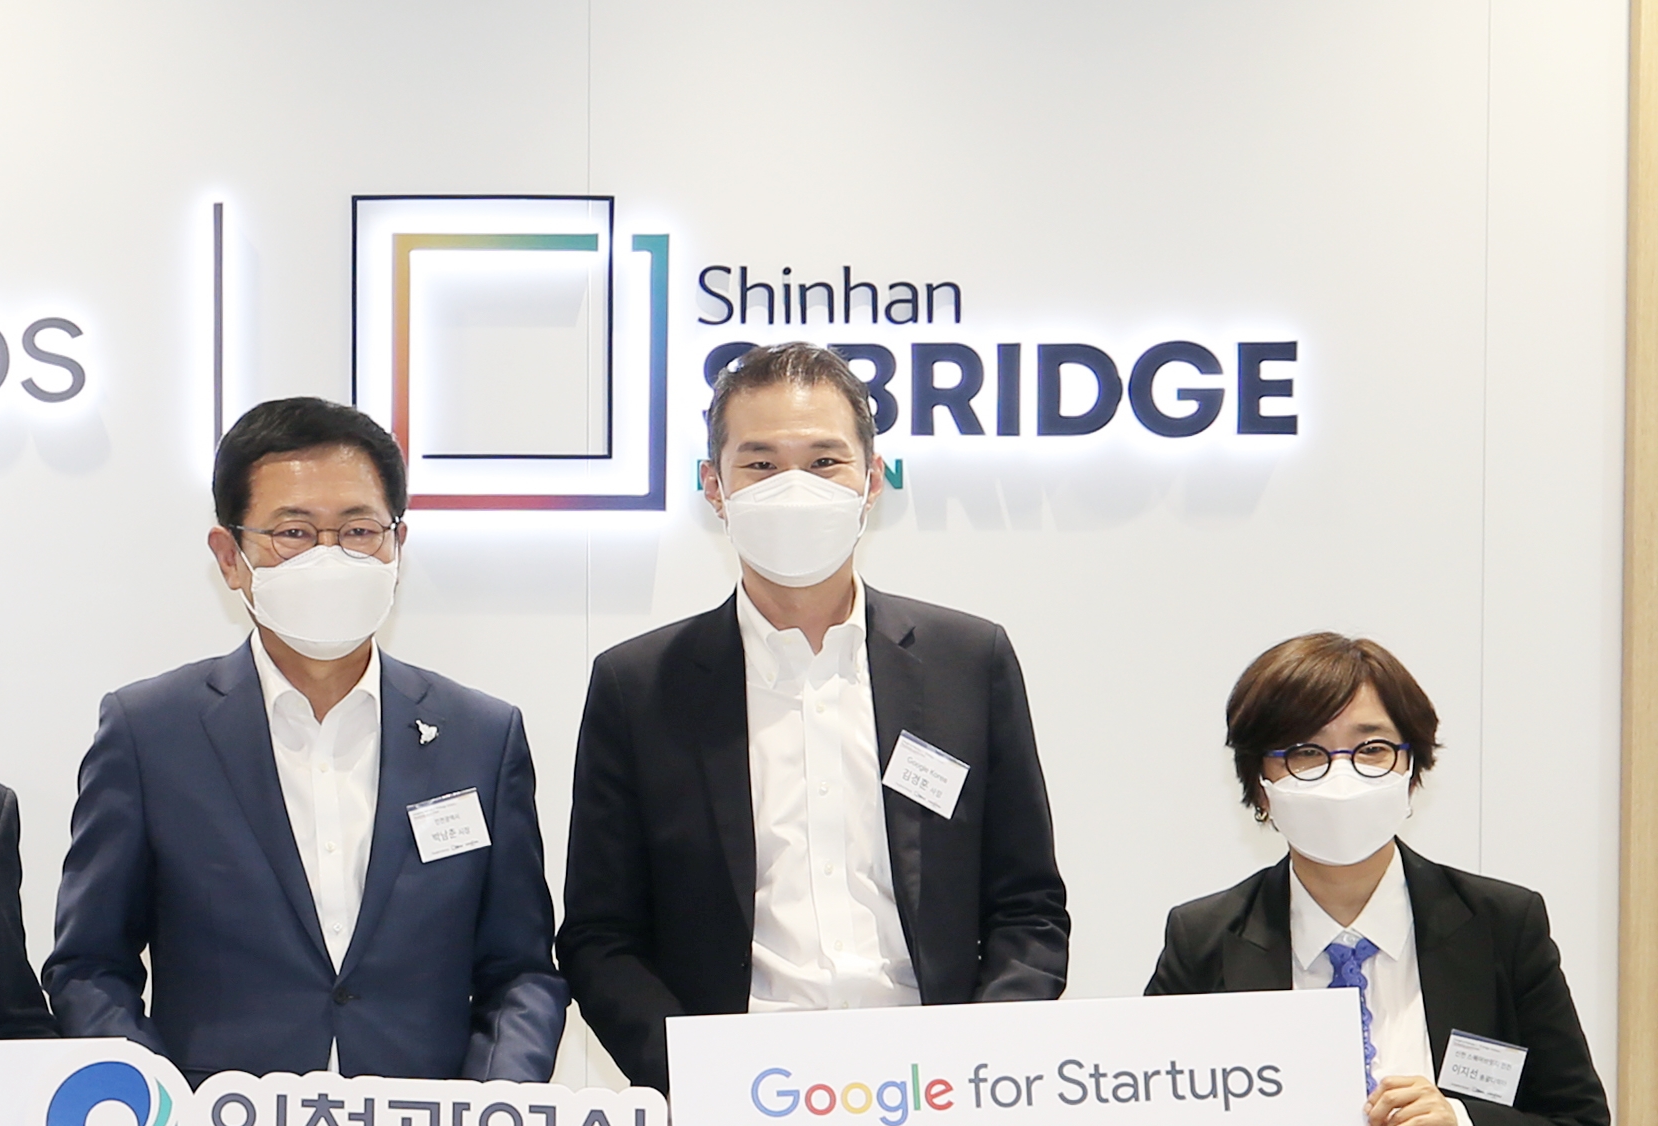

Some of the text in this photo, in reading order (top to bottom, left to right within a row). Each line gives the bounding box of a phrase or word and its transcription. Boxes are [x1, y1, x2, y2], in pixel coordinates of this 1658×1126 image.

[697, 265, 962, 325] Shinhan
[907, 756, 929, 773] Google
[1452, 1063, 1479, 1080] 이지선
[751, 1059, 1284, 1126] Google for Startups
